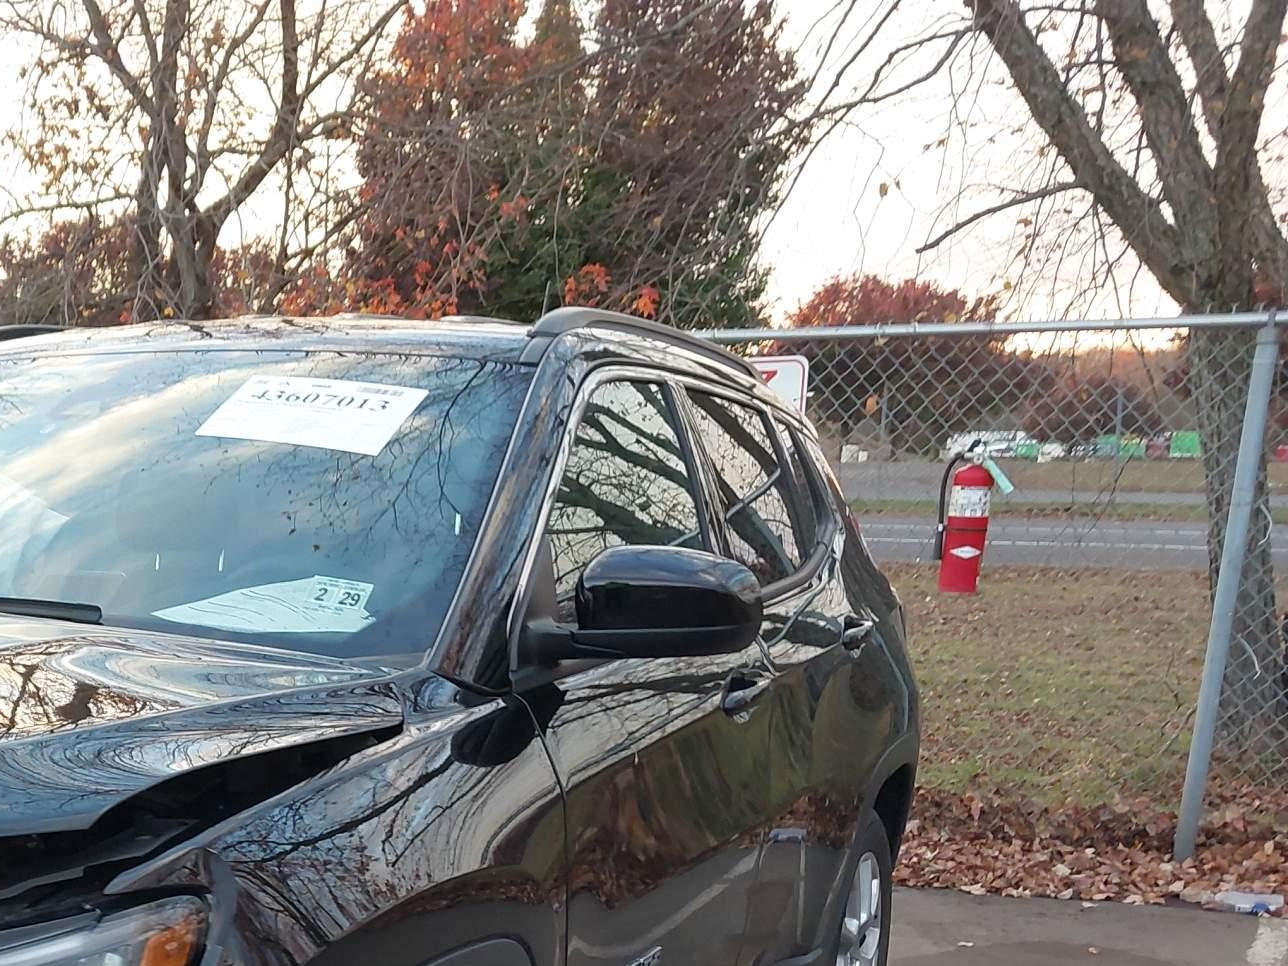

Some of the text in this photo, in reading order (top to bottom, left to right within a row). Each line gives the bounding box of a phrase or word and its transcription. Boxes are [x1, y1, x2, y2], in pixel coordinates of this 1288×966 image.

[251, 389, 390, 411] 43607013
[314, 587, 361, 606] 2 29
